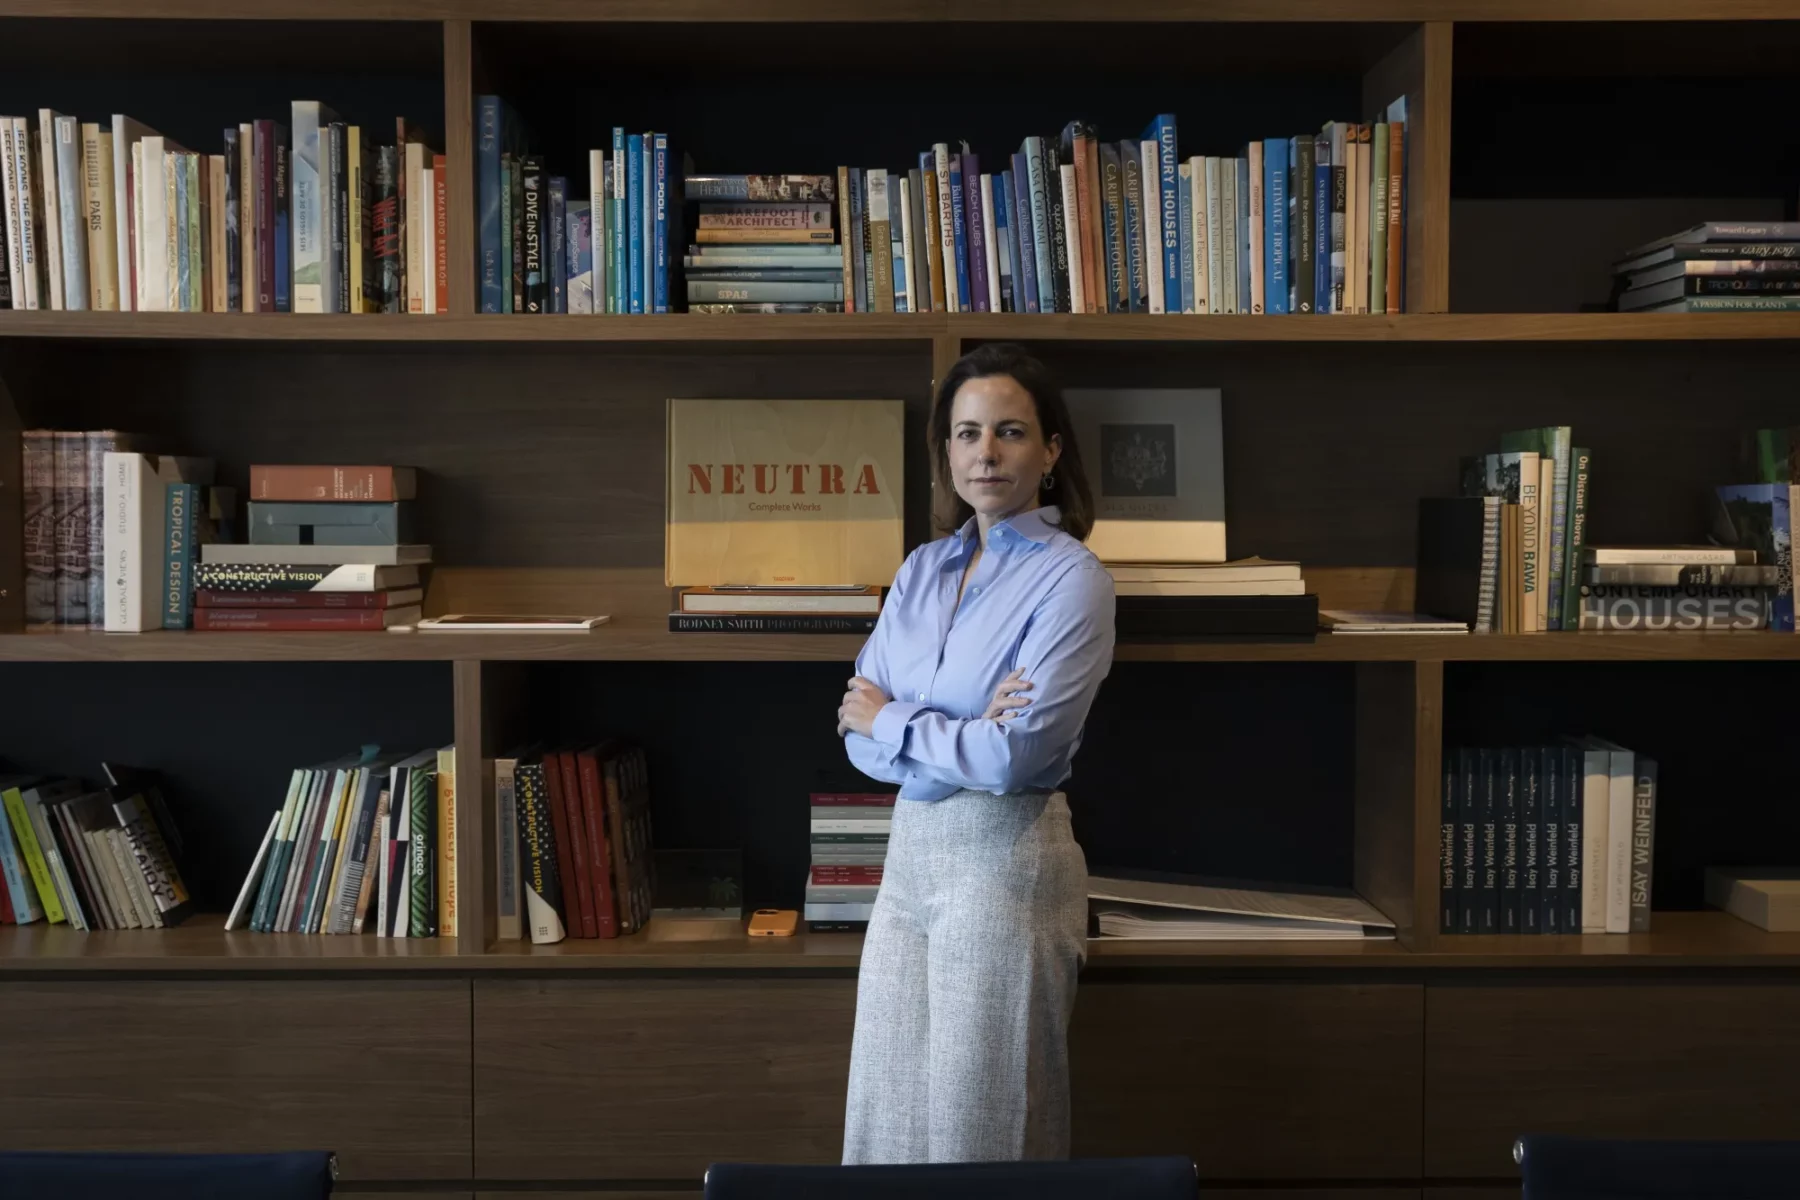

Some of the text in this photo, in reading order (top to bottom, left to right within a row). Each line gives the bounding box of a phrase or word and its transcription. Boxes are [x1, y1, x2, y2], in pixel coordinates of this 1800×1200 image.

[481, 105, 495, 151] POOLS
[18, 154, 27, 191] KOONS
[272, 145, 285, 198] René Magritte
[1161, 126, 1175, 185] LUXURY
[21, 196, 29, 217] THE
[299, 199, 306, 210] DE
[700, 186, 746, 196] HERCULES
[1031, 155, 1046, 248] CASA COLONIAL
[1319, 178, 1325, 188] AN
[1336, 168, 1344, 209] TROPICAL
[90, 200, 102, 231] PARIS
[526, 192, 539, 269] DIVE STYLE
[726, 208, 798, 217] BAREFOOT
[726, 217, 798, 226] ARCHITECT
[940, 170, 953, 248] ST. BARTHS
[952, 185, 962, 235] Bali Modern
[968, 175, 981, 247] BEACH CLUBS
[1106, 163, 1122, 293] CARIBBEAN HOUSES
[1127, 159, 1144, 289] CARIBBEAN HOUSES
[1165, 189, 1177, 249] HOUSES
[1272, 171, 1283, 283] ULTIMATE TROPICAL
[1301, 211, 1310, 241] complete
[1714, 226, 1767, 236] Toward Legacy
[24, 220, 33, 264] PAINTER
[437, 182, 447, 287] ARMANDO REVERÓN
[570, 223, 580, 274] DesignSource
[876, 225, 887, 286] Great Escapes
[1020, 199, 1034, 279] Caribbean Elegance
[1054, 203, 1067, 270] casas de sonho
[1183, 195, 1193, 283] CARIBBEAN STYLE
[1196, 212, 1206, 277] Cuban Elegance
[1210, 197, 1220, 288] French Island Elegance
[1225, 227, 1233, 251] Island
[718, 290, 748, 299] SPAS
[1224, 253, 1233, 288] Elegance
[1691, 300, 1787, 308] A PASSION FOR PLANTS
[687, 464, 881, 495] NEUTRA
[1579, 456, 1588, 470] On
[118, 461, 126, 534] STUDIO HOME
[749, 502, 821, 513] Complete Works
[1575, 473, 1586, 510] Distant
[169, 489, 184, 613] TROPICAL DESIGN
[1523, 484, 1536, 594] BEYOND BAWA
[1554, 534, 1562, 547] the
[1573, 513, 1584, 547] Shores
[202, 572, 323, 581] A CONSTRUCTIVE VISION
[1553, 549, 1562, 572] World
[120, 586, 128, 625] GLOBAL
[1579, 597, 1760, 630] HOUSES
[1580, 585, 1758, 598] CONTEMPORARY
[679, 619, 852, 629] RODNEY SMITH PHOTOGRAPHS
[416, 834, 426, 876] orinoco
[524, 784, 539, 858] CONSTRUCTIVE
[533, 859, 543, 893] VISION
[1465, 823, 1475, 889] Isay Weinfeld
[1484, 823, 1494, 889] Isay Weinfeld
[1505, 823, 1516, 889] Isay Weinfeld
[1526, 823, 1537, 889] Isay Weinfeld
[1547, 823, 1557, 889] Isay Weinfeld
[1568, 823, 1579, 889] Isay Weinfeld
[1632, 776, 1652, 908] ISAY WEINFELD
